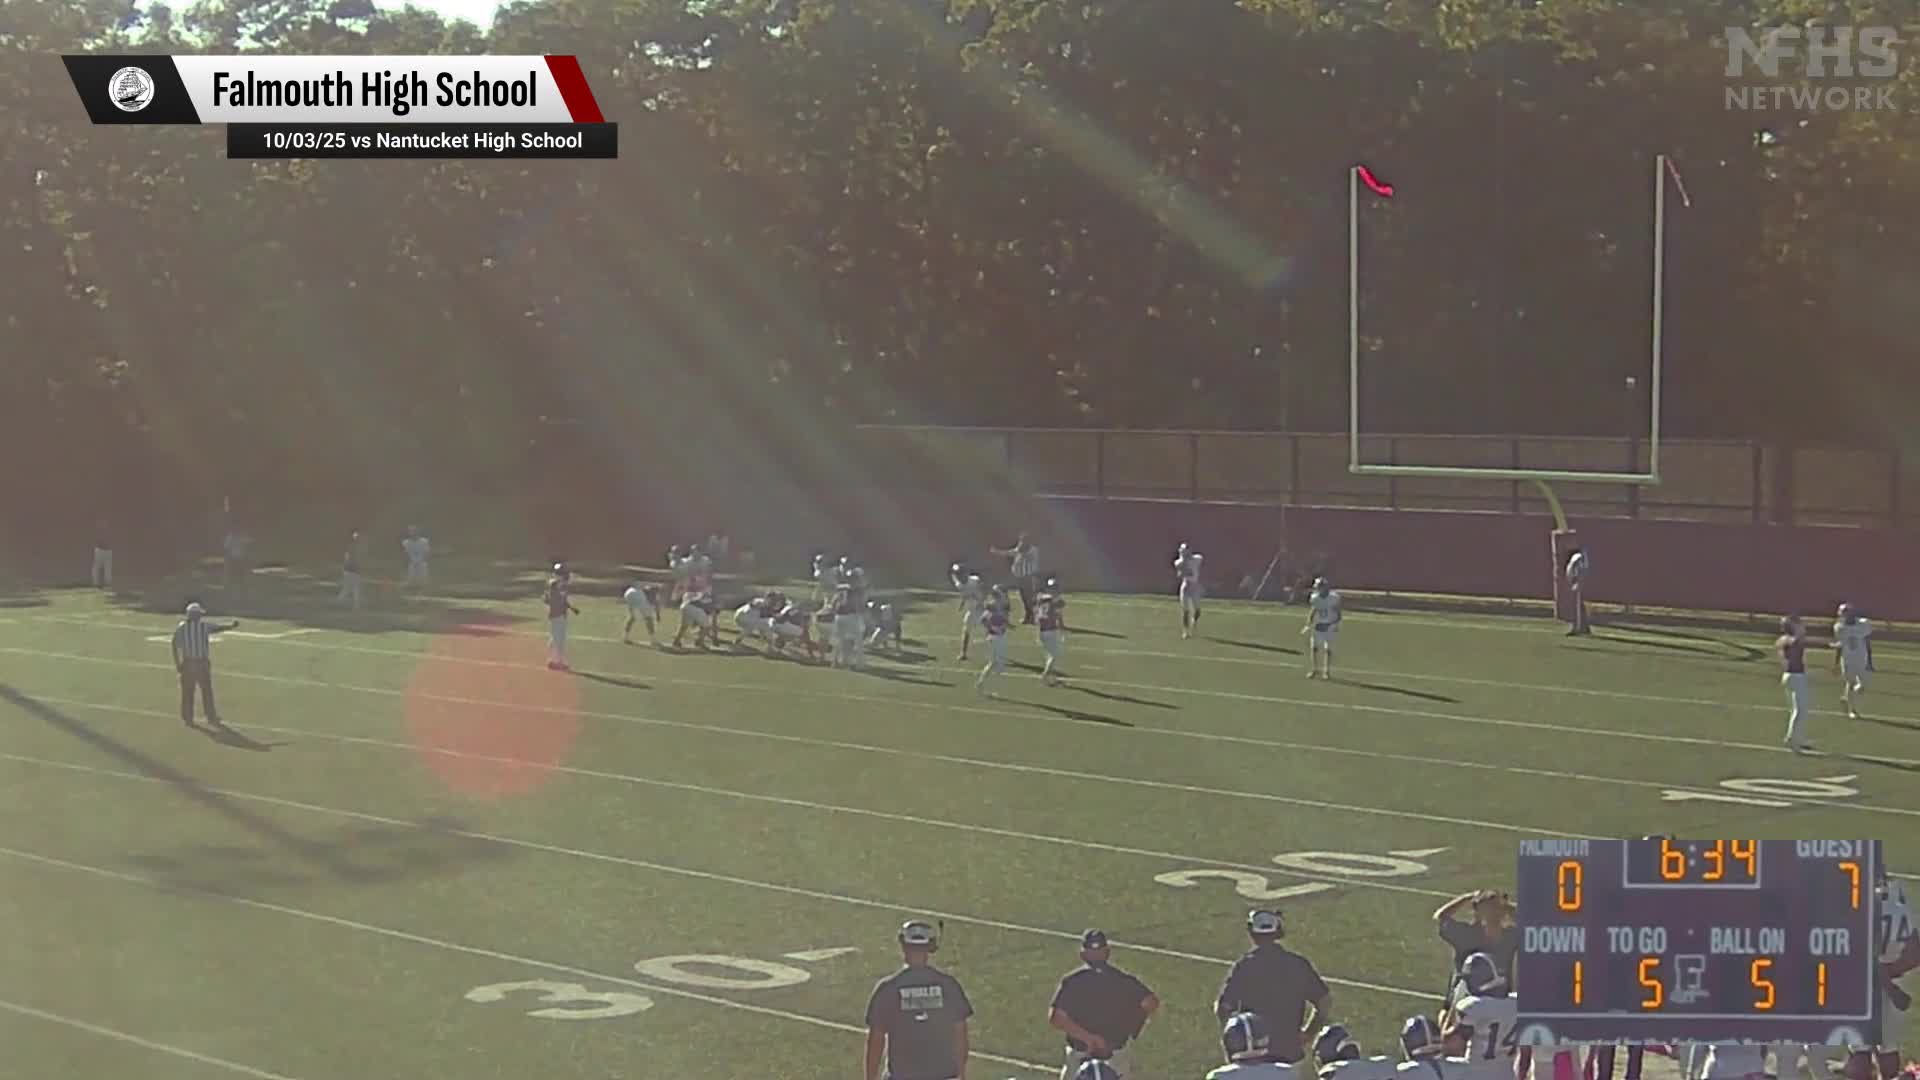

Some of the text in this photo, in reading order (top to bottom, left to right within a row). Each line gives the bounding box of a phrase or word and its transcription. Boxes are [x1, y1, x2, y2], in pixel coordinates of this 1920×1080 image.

[1661, 840, 1756, 879] 6:34
[1796, 840, 1863, 858] GUEST
[1558, 861, 1582, 910] 0
[1838, 862, 1860, 909] 7
[1524, 926, 1586, 953] DOWN
[1607, 926, 1667, 953] TO GO
[1710, 927, 1785, 955] BALL ON
[1809, 927, 1850, 956] QTR
[465, 954, 811, 1020] 30
[1573, 961, 1583, 1005] 1
[1639, 958, 1663, 1008] 5
[1751, 958, 1775, 1010] 5
[1816, 962, 1826, 1006] 1
